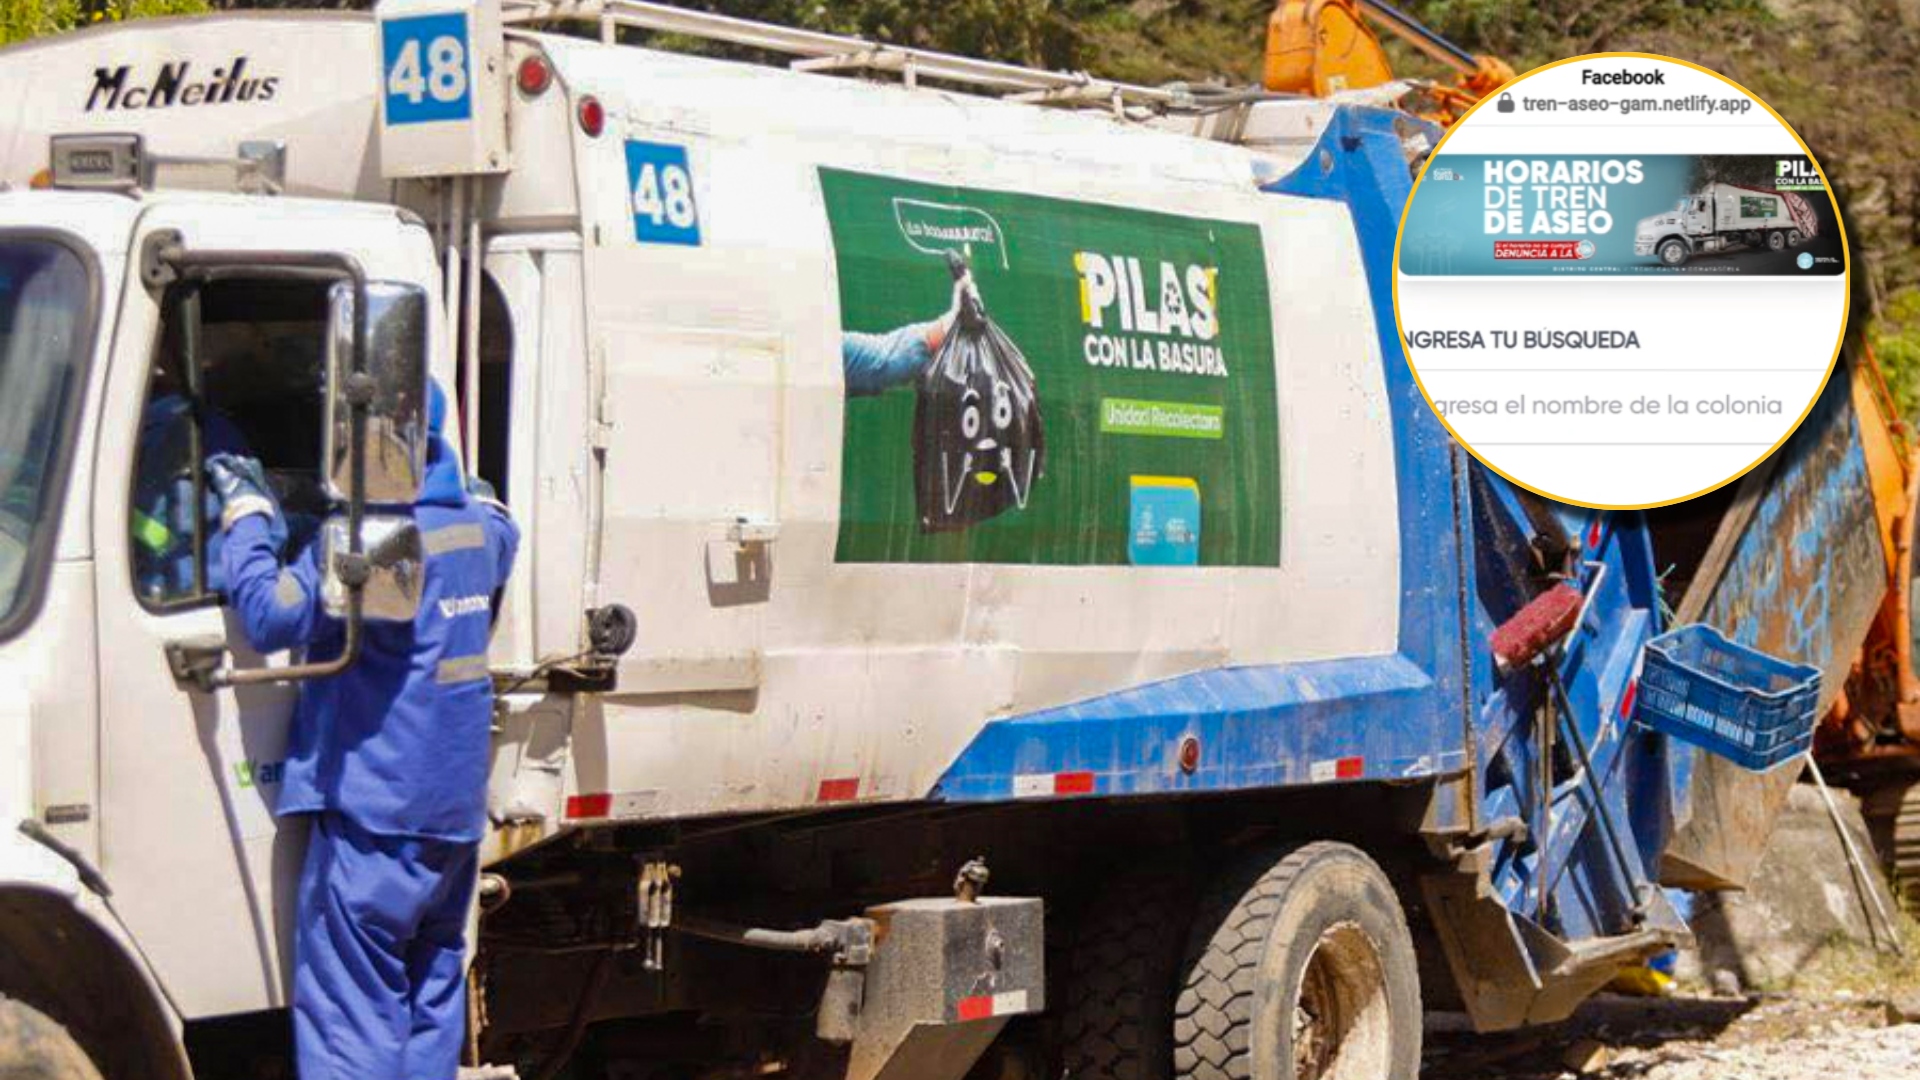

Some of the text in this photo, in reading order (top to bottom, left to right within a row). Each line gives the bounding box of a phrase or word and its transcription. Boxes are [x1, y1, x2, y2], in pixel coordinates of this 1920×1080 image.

[84, 57, 279, 112] McNeilus
[387, 35, 469, 104] 48
[633, 163, 696, 229] 48
[1084, 334, 1229, 377] CON LA BASURA
